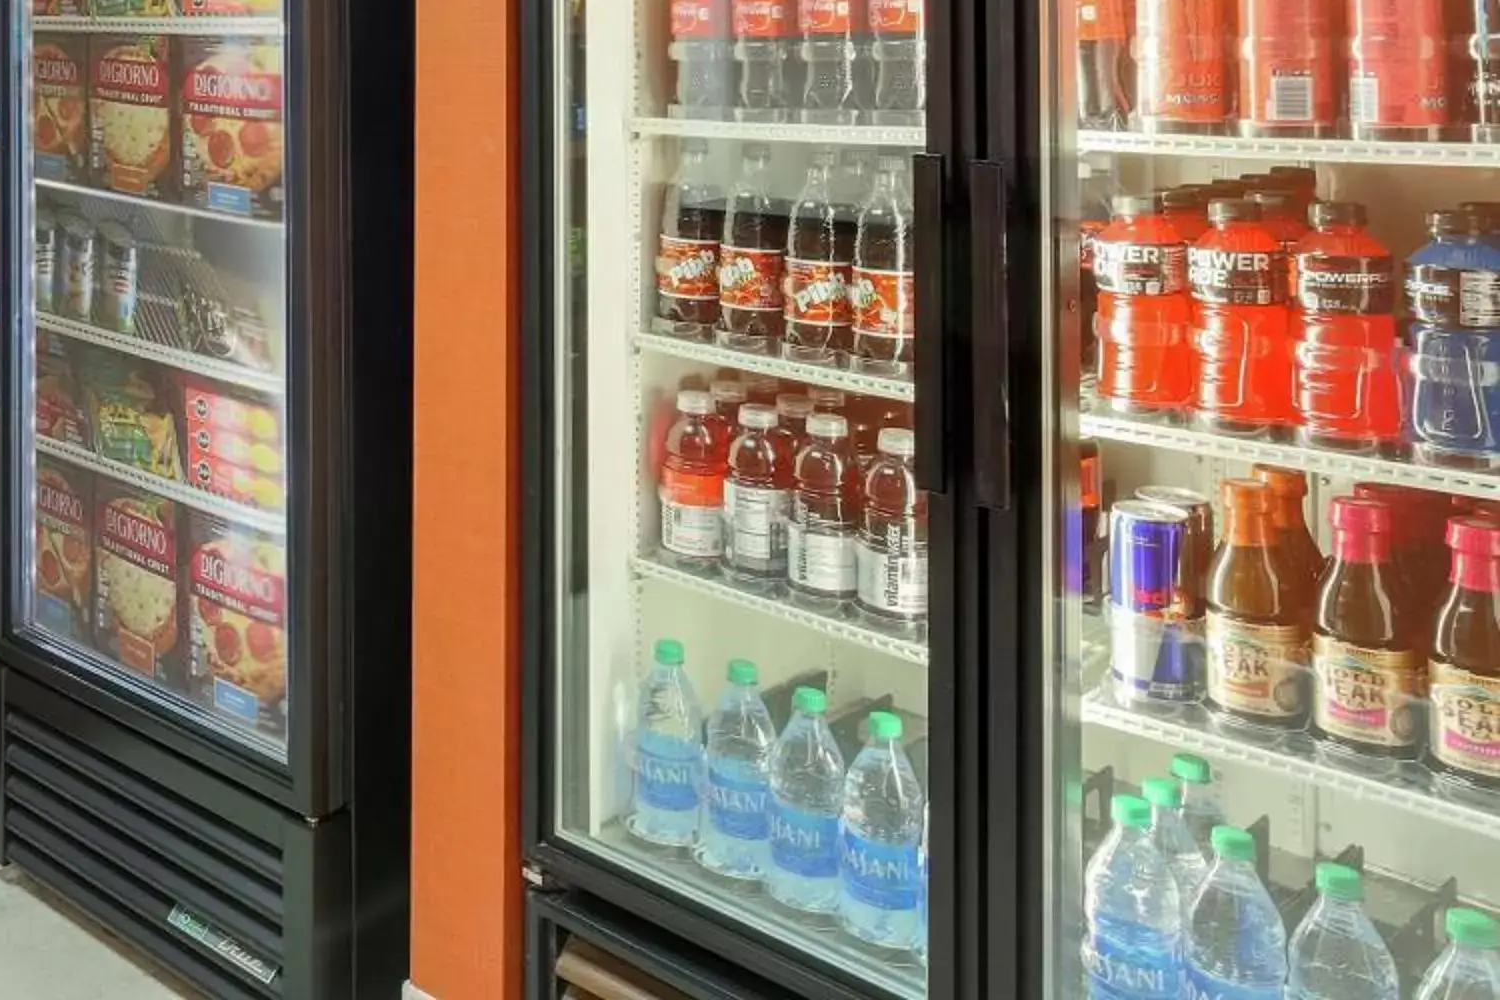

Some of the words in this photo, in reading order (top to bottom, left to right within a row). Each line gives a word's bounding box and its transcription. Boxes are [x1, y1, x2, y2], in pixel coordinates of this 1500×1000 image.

[100, 60, 160, 88] DIGIORNO
[194, 73, 271, 101] DIGIORNO
[1187, 249, 1270, 272] POWER
